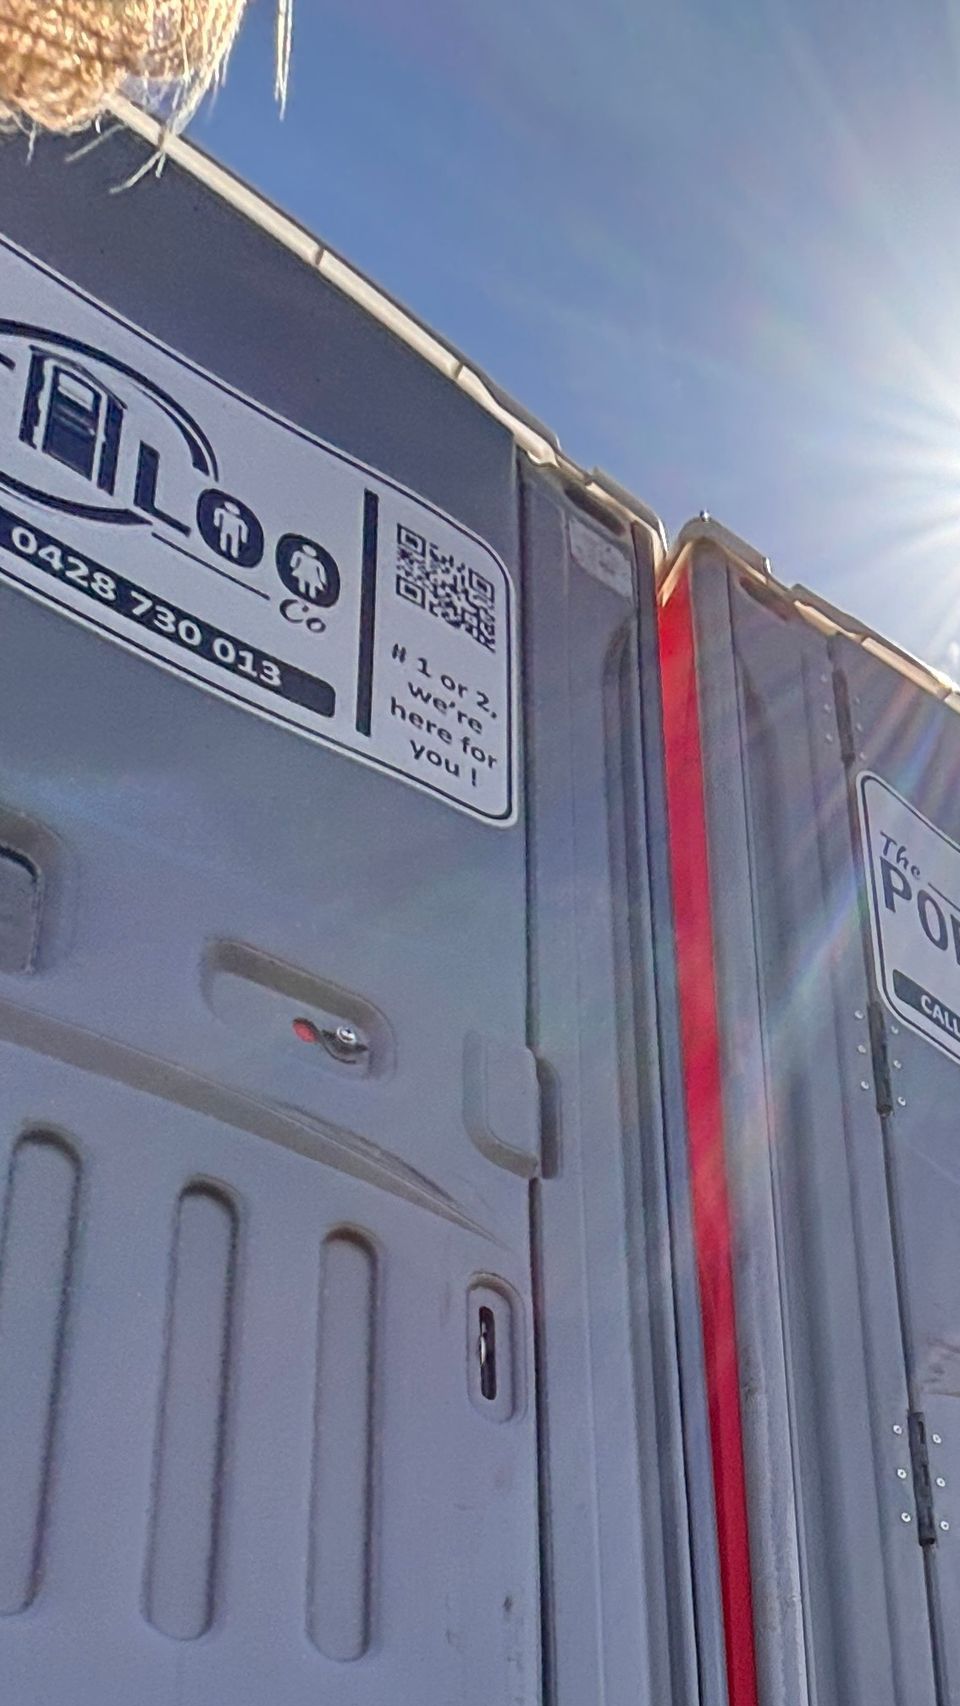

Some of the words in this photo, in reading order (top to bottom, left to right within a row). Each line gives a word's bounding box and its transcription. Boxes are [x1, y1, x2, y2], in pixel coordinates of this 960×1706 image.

[11, 526, 117, 601] 0428
[128, 591, 202, 646] 730
[212, 638, 282, 687] 013
[279, 599, 326, 634] Co
[417, 657, 432, 678] 1
[440, 674, 468, 698] or
[391, 696, 453, 745] here
[460, 736, 497, 769] for
[408, 681, 483, 735] we're
[410, 739, 460, 777] you
[880, 830, 921, 881] The
